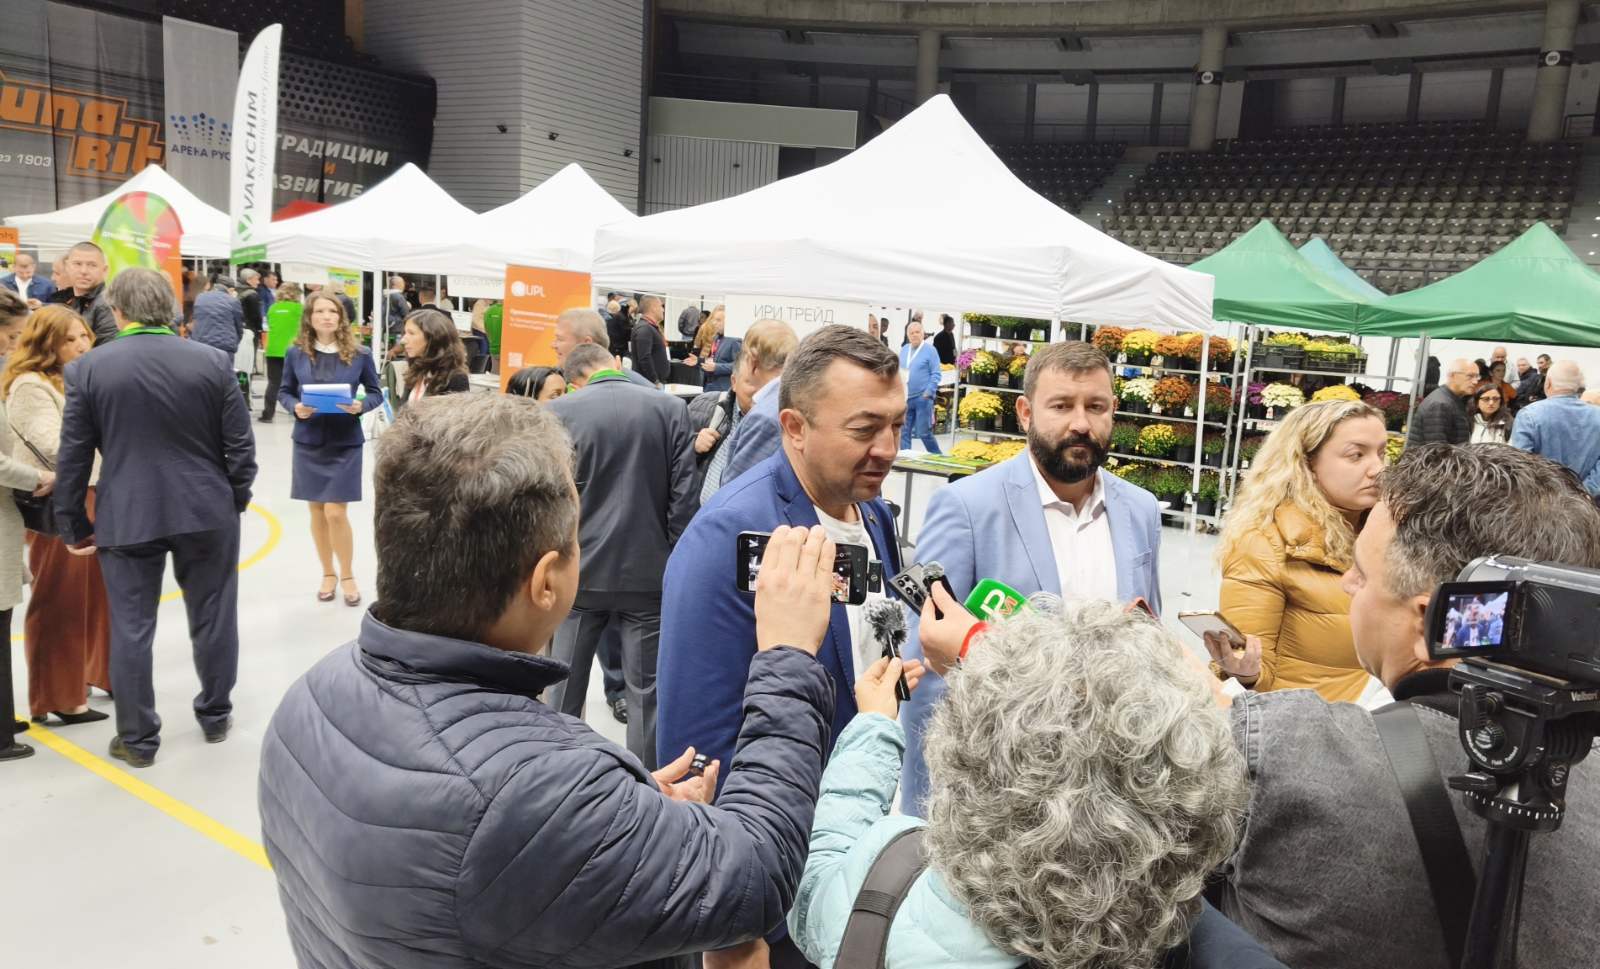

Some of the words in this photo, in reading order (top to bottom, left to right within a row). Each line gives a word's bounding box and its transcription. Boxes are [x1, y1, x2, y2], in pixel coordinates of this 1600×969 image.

[74, 123, 162, 174] Rit
[171, 144, 208, 158] АРЕНА
[244, 91, 258, 209] VAKICHIM
[277, 133, 389, 166] РАДИЦИИ
[17, 153, 52, 167] 1903
[524, 284, 546, 298] UPL
[754, 304, 783, 319] ИРИ
[788, 306, 834, 324] ТРЕЙД
